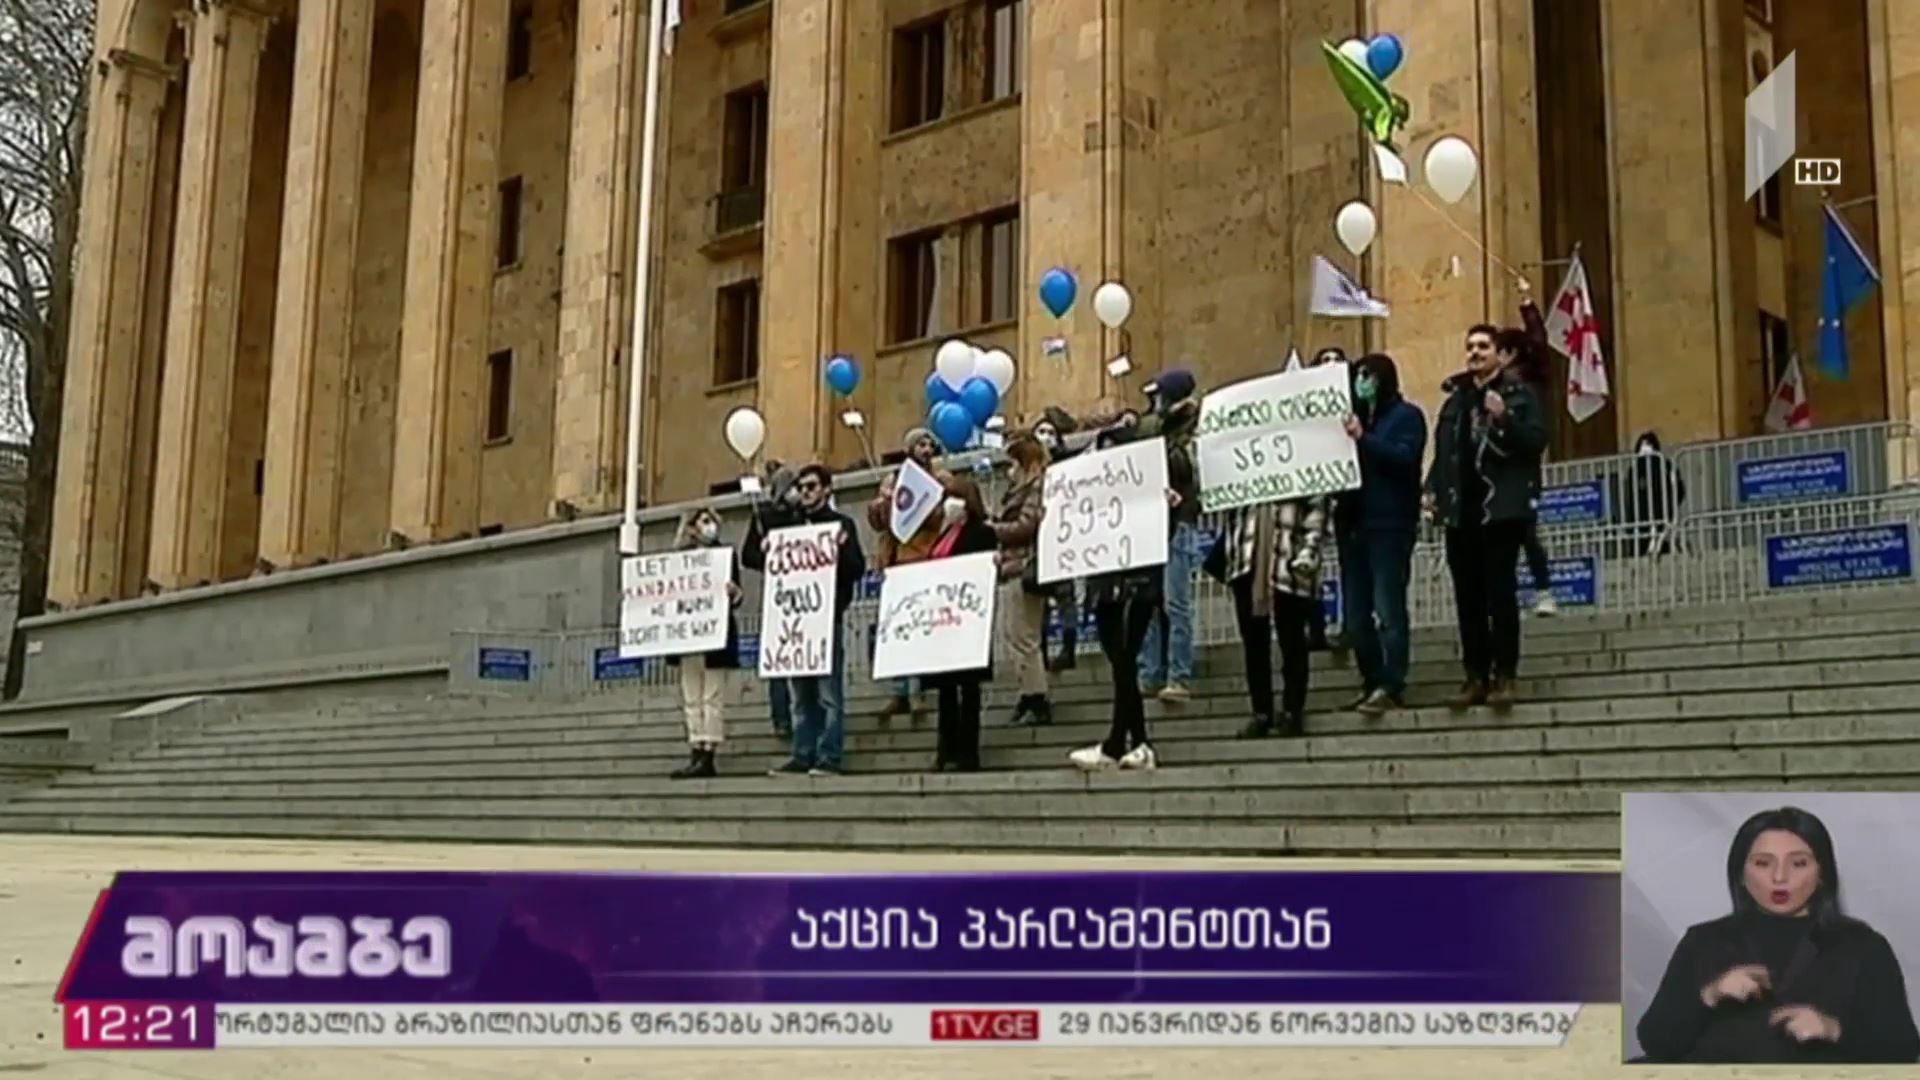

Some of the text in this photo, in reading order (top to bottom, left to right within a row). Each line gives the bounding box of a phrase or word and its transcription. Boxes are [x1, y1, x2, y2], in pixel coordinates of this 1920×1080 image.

[636, 552, 711, 577] LET THE
[625, 572, 712, 599] MANDATES
[665, 621, 687, 640] THE
[691, 619, 718, 638] WAY
